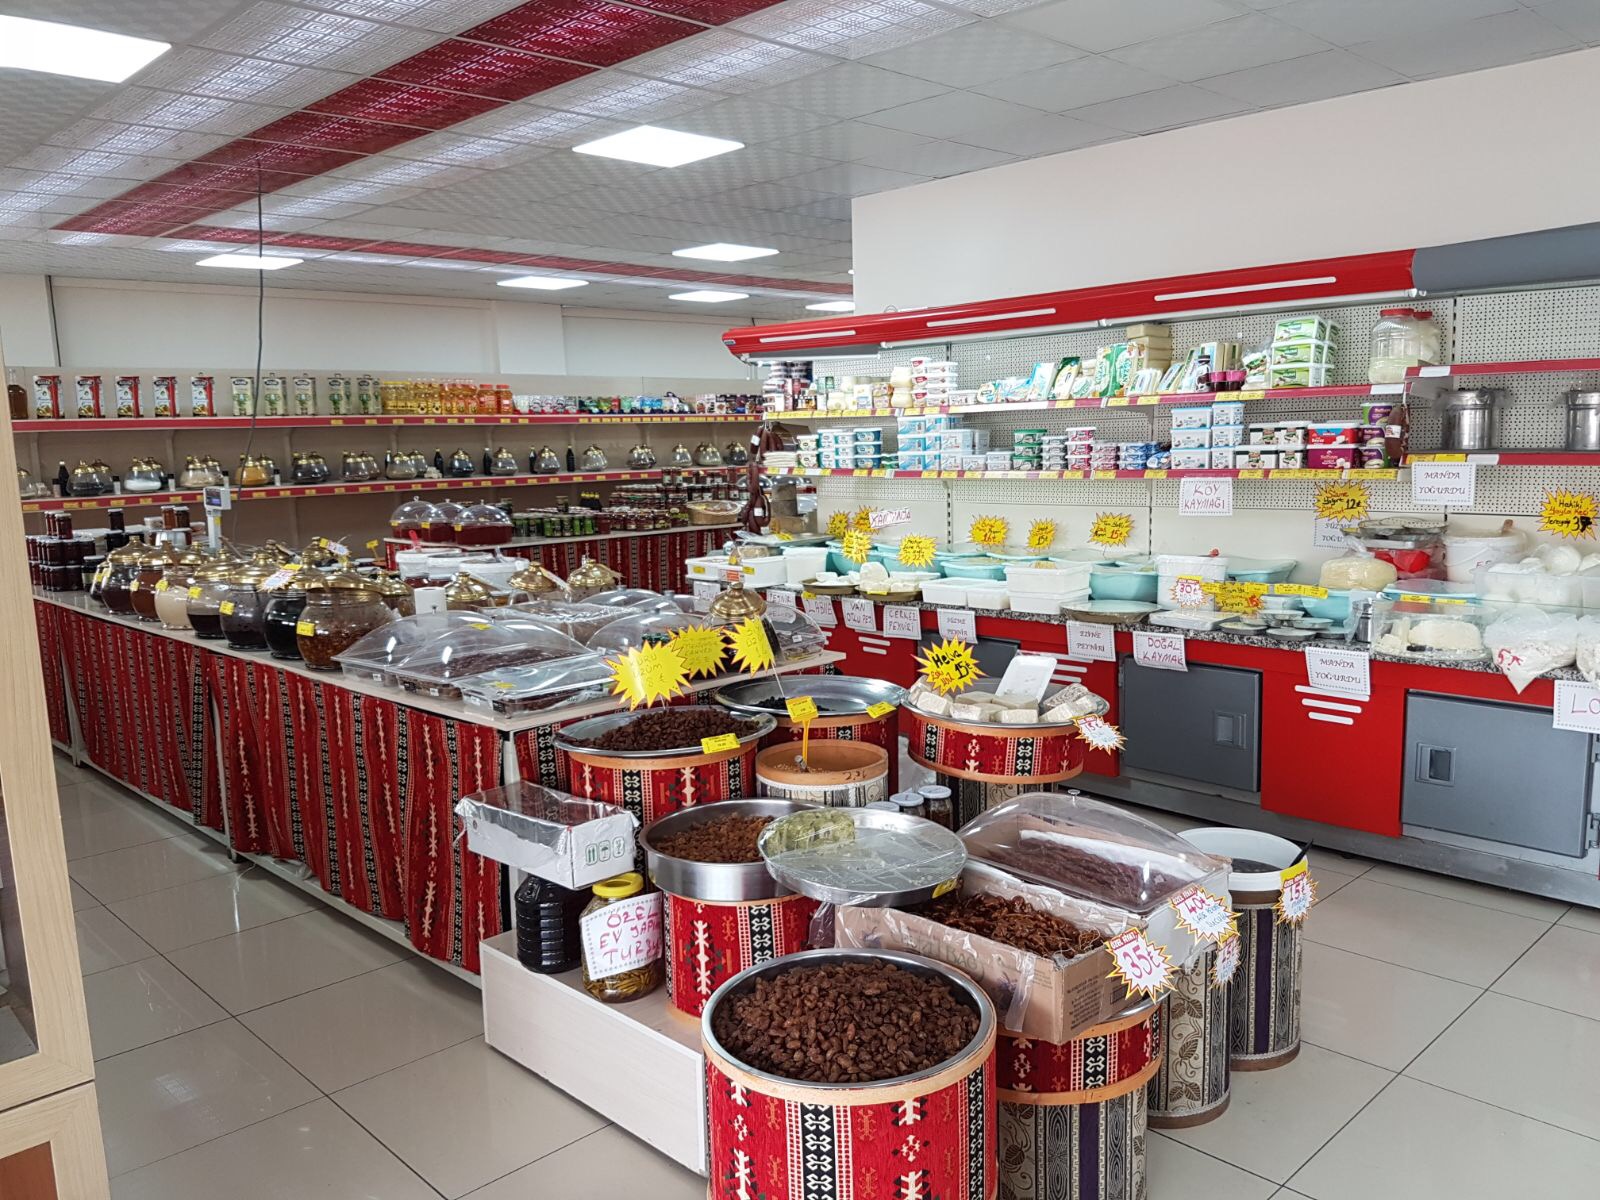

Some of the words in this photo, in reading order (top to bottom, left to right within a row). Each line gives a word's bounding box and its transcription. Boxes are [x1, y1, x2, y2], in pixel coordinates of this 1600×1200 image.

[1423, 470, 1461, 480] MANDA
[1184, 497, 1225, 510] KAYMAĞI
[1147, 635, 1181, 651] DOĞAL
[1142, 650, 1184, 667] KAYMAK
[1320, 658, 1355, 668] MANDA
[599, 928, 623, 949] EV
